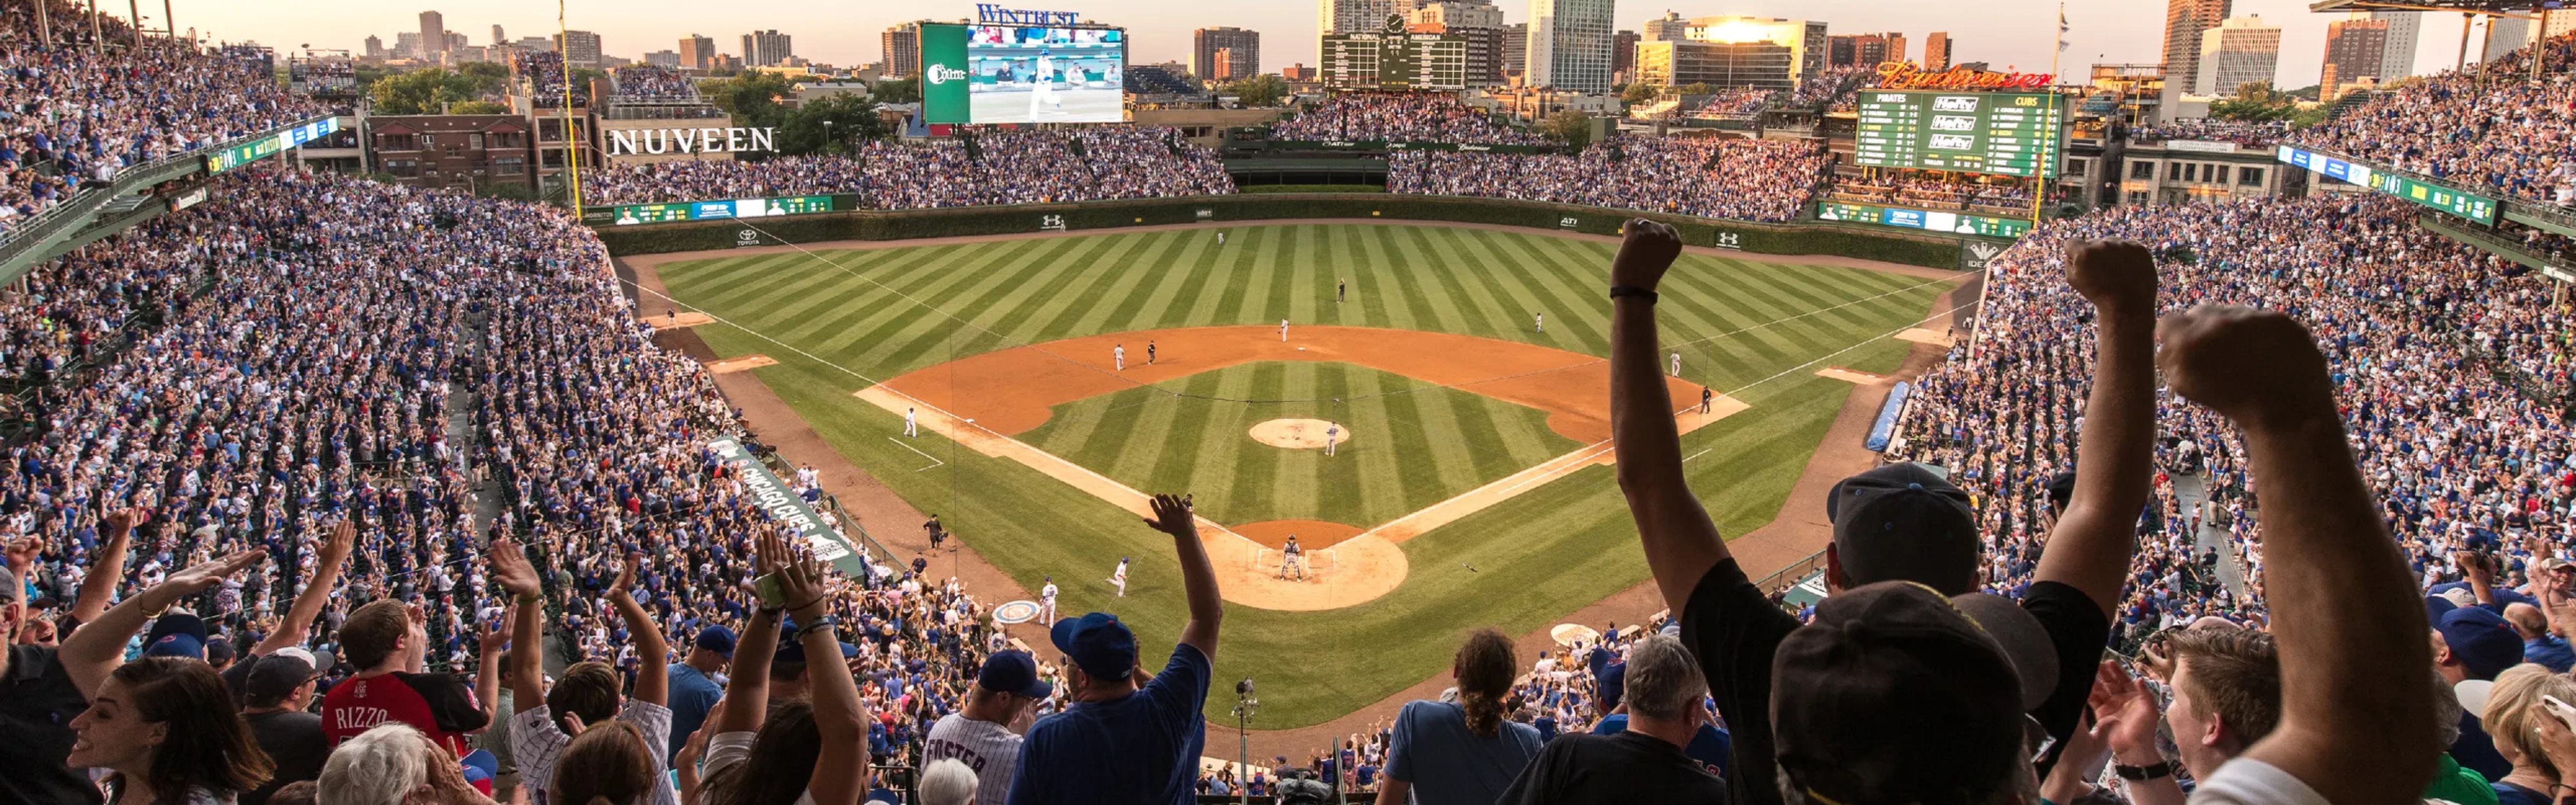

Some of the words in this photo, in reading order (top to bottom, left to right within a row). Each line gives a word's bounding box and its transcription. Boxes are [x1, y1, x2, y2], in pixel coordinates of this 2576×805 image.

[1875, 60, 2057, 89] Budweiser
[1877, 94, 1906, 102] PIRATES
[2014, 96, 2039, 107] CUBS
[611, 127, 774, 155] NUVEEN
[743, 467, 790, 510] CHICAGO
[335, 706, 387, 729] RIZZO
